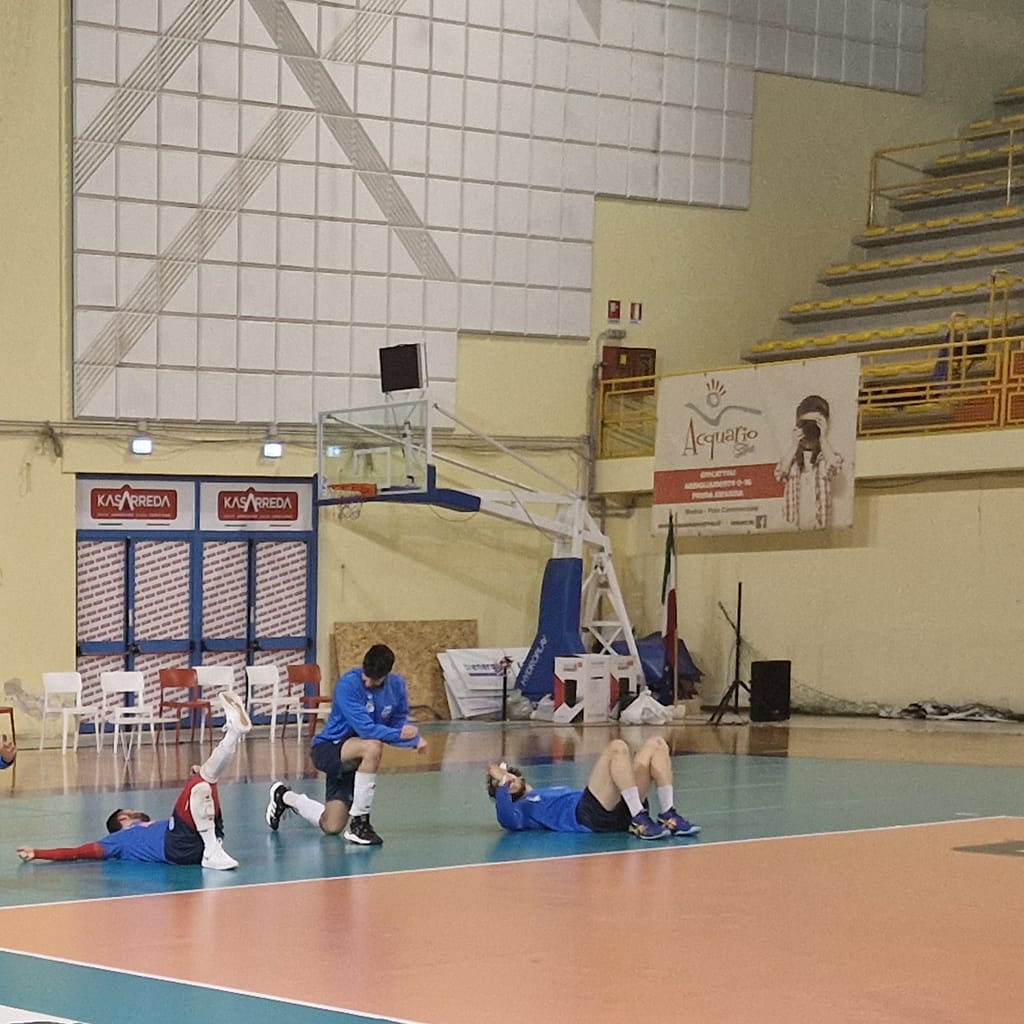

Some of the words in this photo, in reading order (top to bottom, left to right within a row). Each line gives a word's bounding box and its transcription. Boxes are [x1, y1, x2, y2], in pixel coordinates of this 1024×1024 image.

[682, 418, 758, 460] Acquario
[97, 490, 170, 511] KASARREDA
[223, 492, 292, 513] KASARREDA
